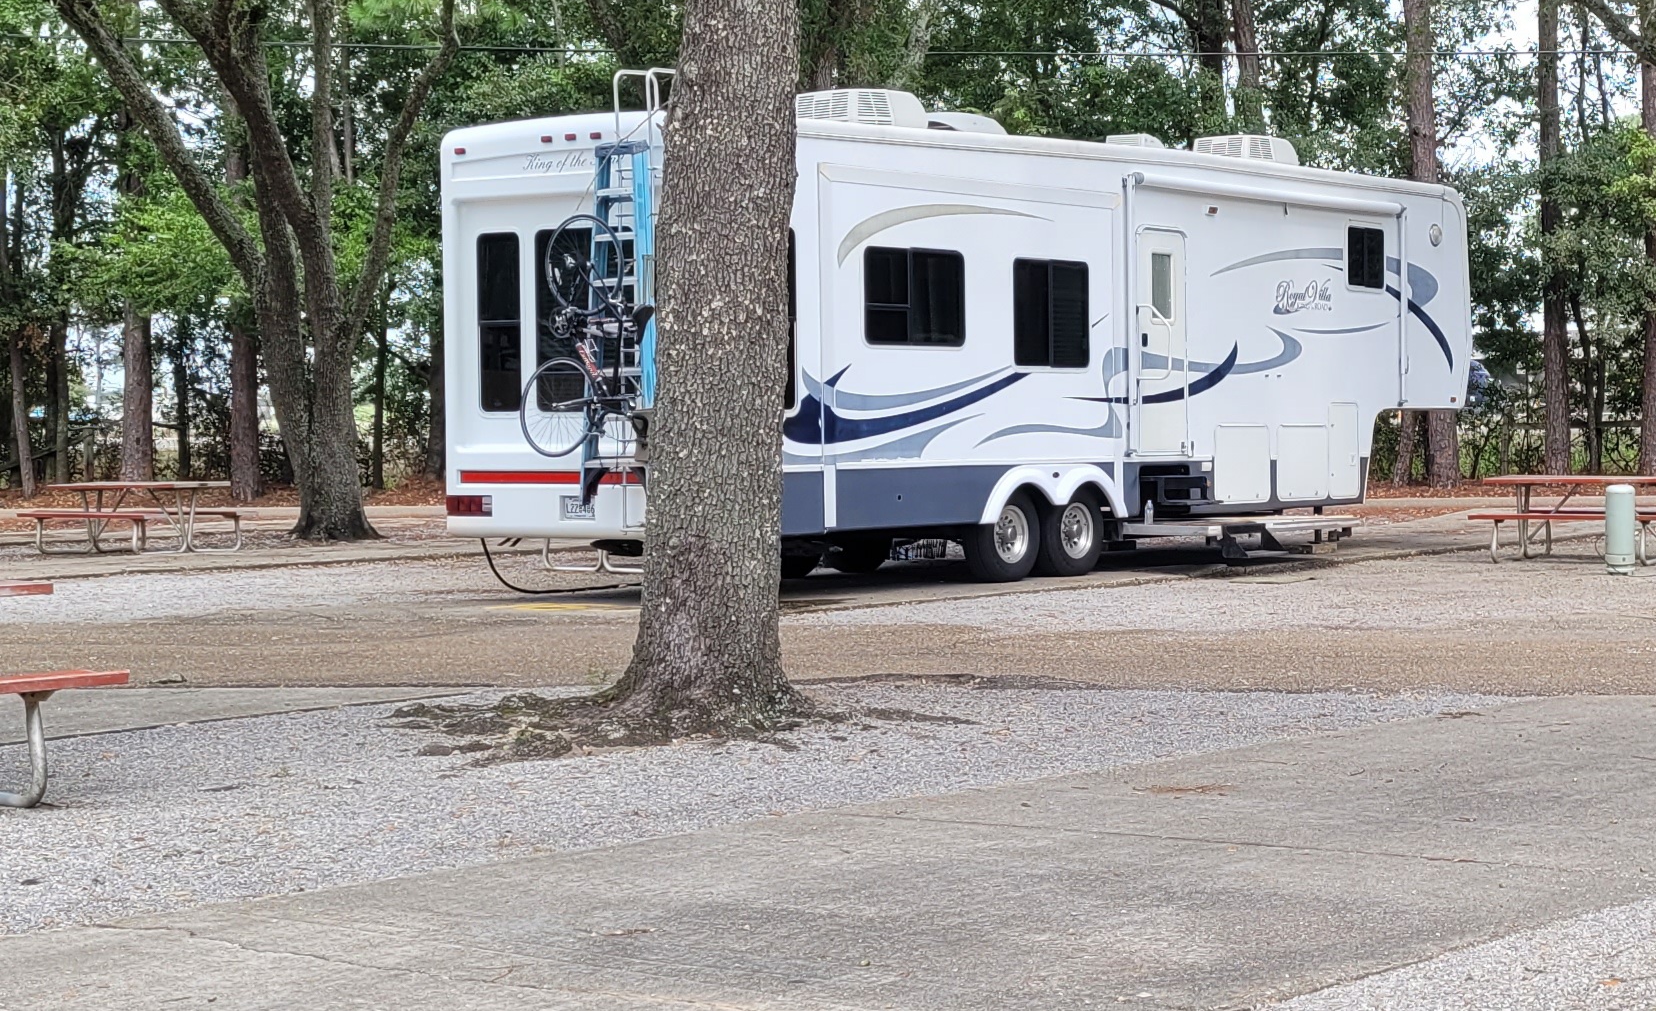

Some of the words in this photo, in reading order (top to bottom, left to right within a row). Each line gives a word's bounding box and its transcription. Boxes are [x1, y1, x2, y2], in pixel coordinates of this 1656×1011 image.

[523, 153, 553, 174] King
[555, 151, 572, 173] of
[570, 150, 588, 168] the
[1275, 279, 1307, 309] Royal
[1305, 278, 1332, 302] Villa
